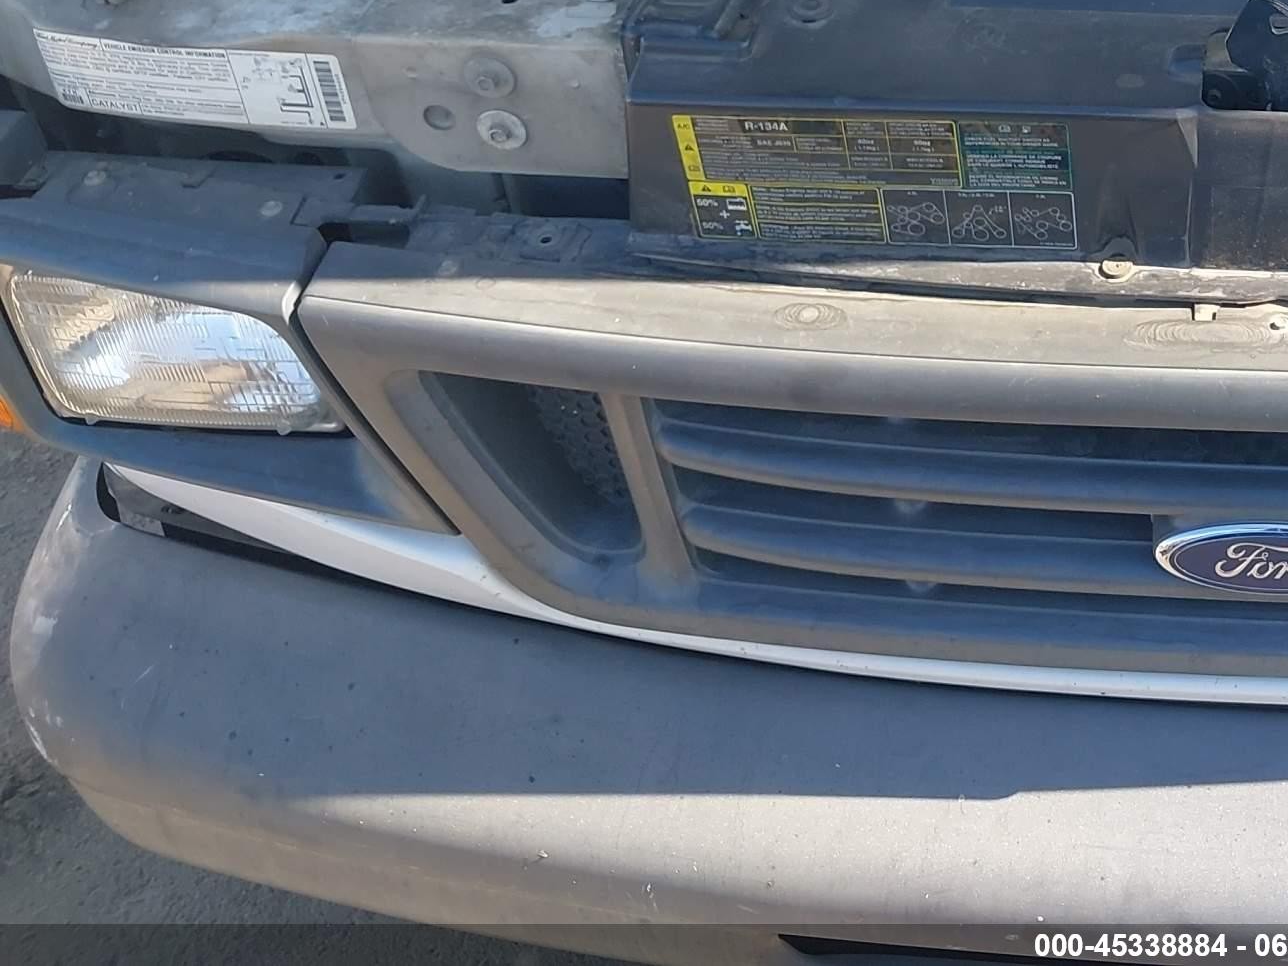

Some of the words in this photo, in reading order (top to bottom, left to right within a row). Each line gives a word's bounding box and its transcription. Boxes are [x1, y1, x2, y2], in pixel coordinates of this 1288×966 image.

[103, 43, 126, 51] VEHICLE
[128, 45, 155, 54] EMISSION
[157, 48, 183, 56] CONTROL
[185, 50, 226, 59] INFORMATION
[92, 98, 139, 113] CATALYST
[744, 121, 789, 132] R-134A
